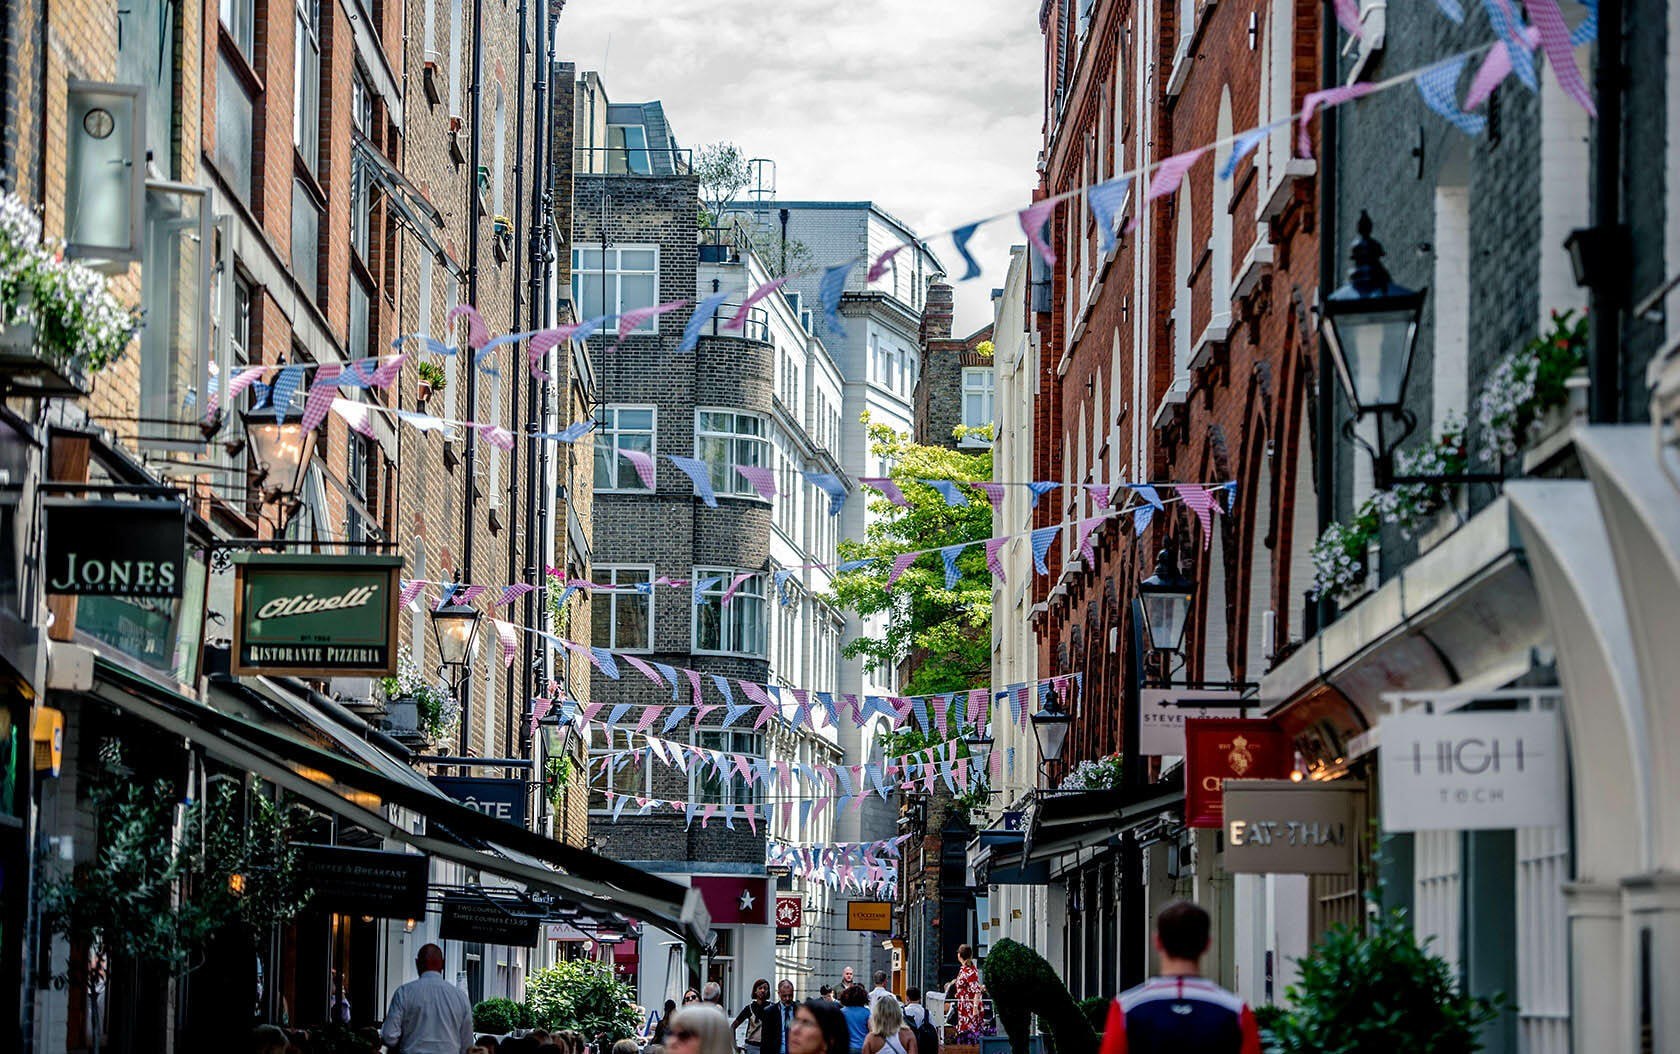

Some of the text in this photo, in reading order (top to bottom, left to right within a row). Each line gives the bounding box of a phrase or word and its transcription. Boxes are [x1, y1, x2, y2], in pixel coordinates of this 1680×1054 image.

[51, 553, 176, 590] JONES
[257, 584, 379, 619] Olivelli
[250, 645, 380, 663] RISTORANTE PIZZERIA
[1412, 738, 1525, 774] HIGH
[450, 795, 512, 819] ÔTE
[1229, 820, 1346, 847] EAT-THAI
[354, 864, 408, 879] BREAKFAST
